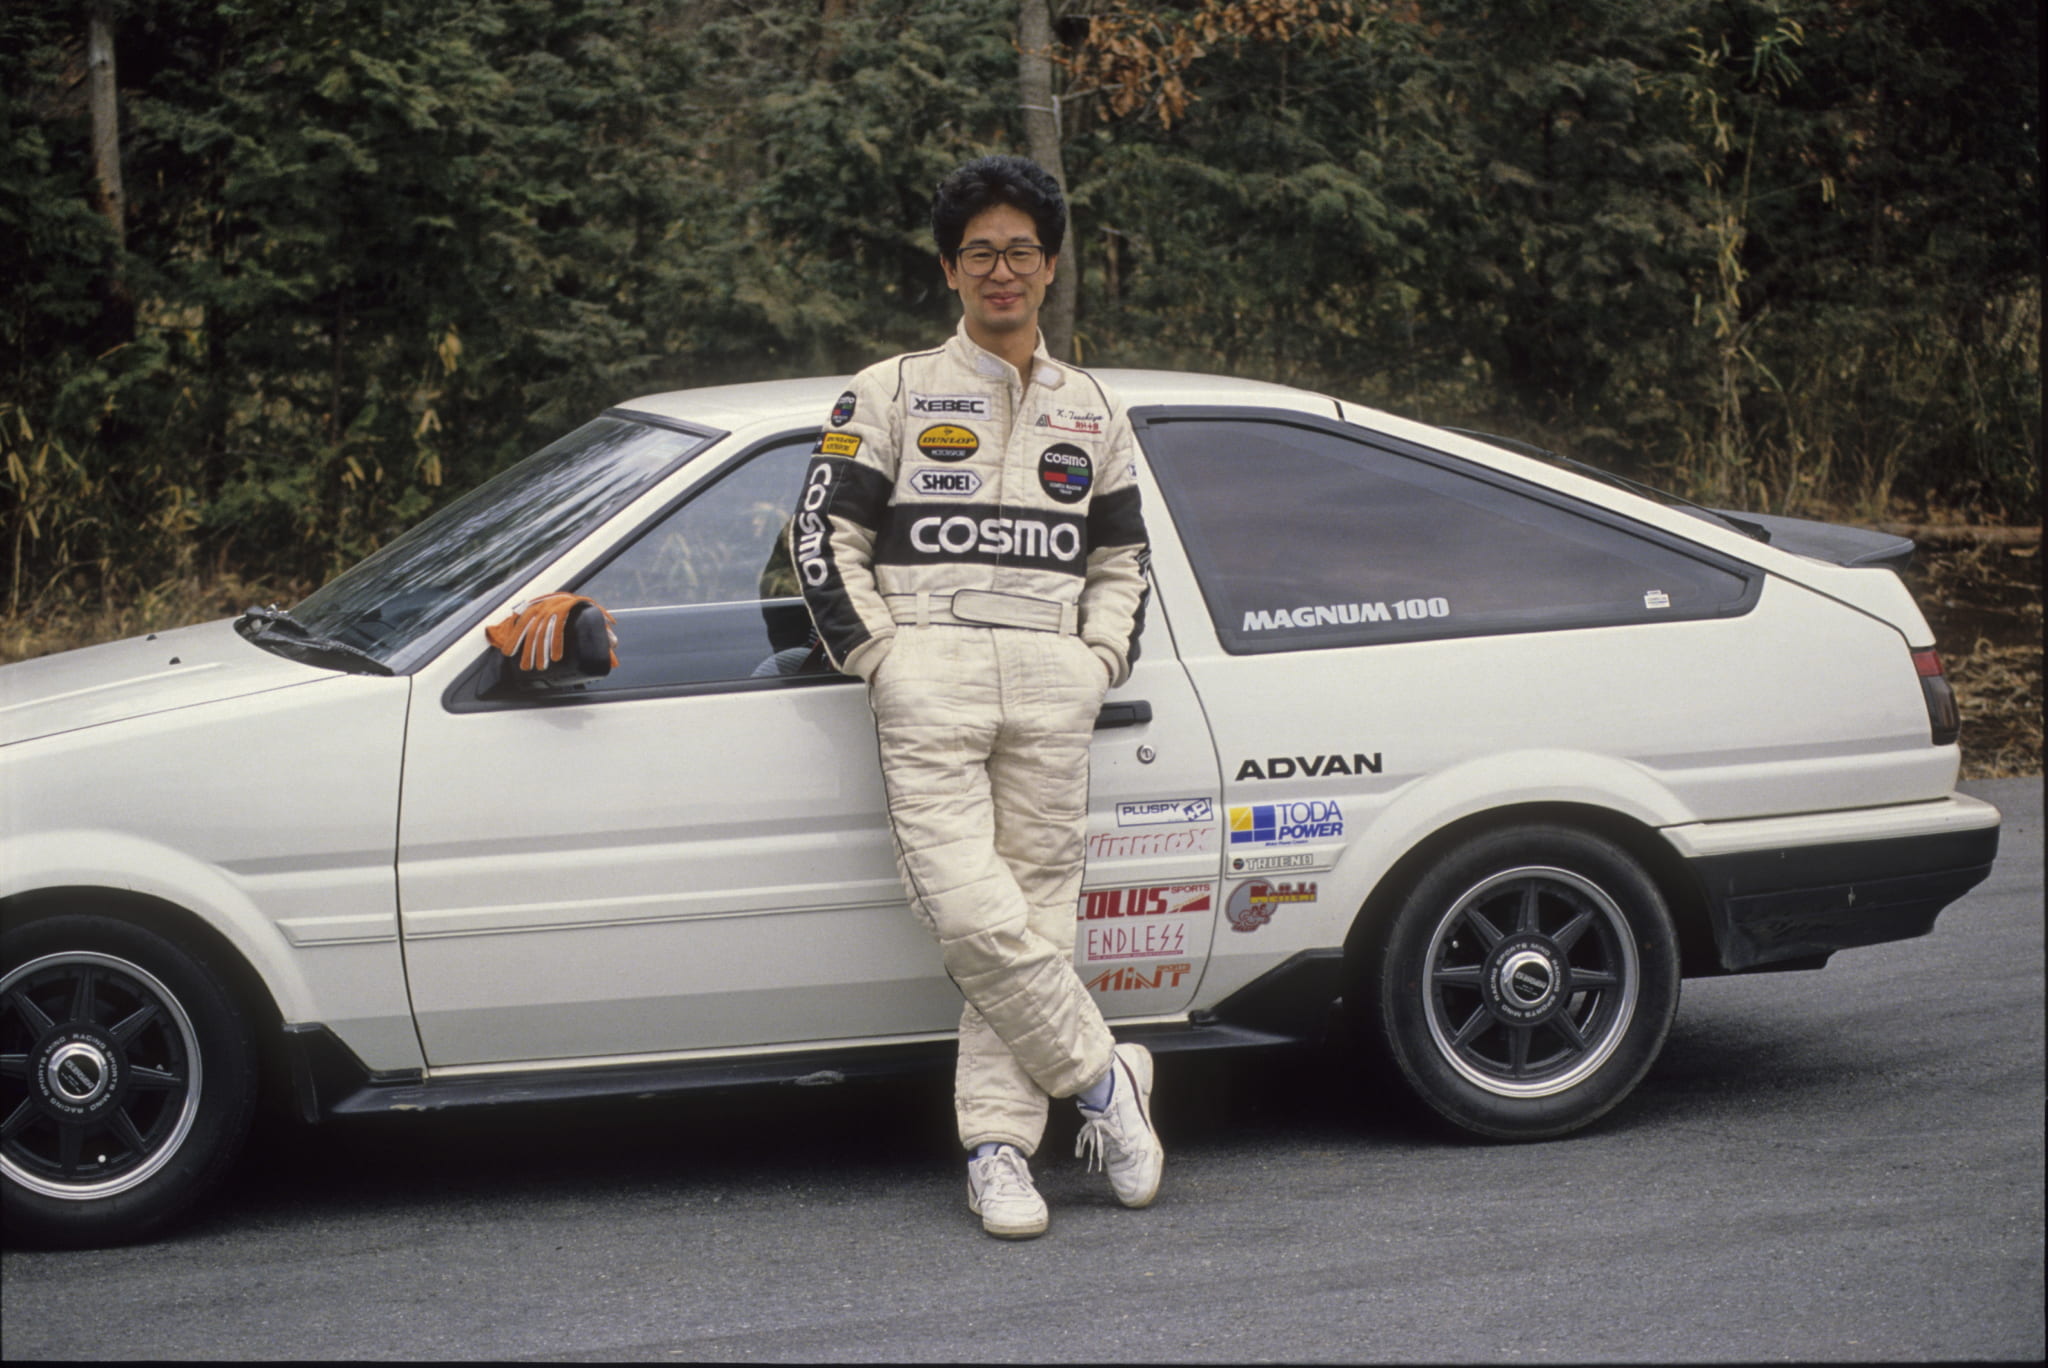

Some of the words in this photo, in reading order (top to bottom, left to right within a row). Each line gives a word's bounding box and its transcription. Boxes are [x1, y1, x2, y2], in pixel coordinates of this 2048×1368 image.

[913, 398, 984, 414] XEBEC
[922, 437, 975, 445] DUNLOP
[1044, 452, 1088, 468] COSMO
[922, 474, 970, 491] SHOEI
[798, 463, 832, 587] COSMO
[910, 515, 1081, 562] COSMO
[1242, 602, 1392, 632] MAGNUM
[1392, 597, 1450, 620] 100
[1235, 752, 1383, 781] ADVAN
[1122, 803, 1180, 816] PLUSPY
[1276, 800, 1343, 825] TODA
[1278, 822, 1344, 841] POWER
[1246, 853, 1314, 871] TRUENO
[1171, 884, 1210, 894] SPORTS
[1088, 923, 1184, 955] ENDLESS
[1496, 943, 1527, 965] SPORTS
[45, 1036, 66, 1054] MIND
[72, 1033, 106, 1050] RACING
[106, 1051, 118, 1091] SPORTS
